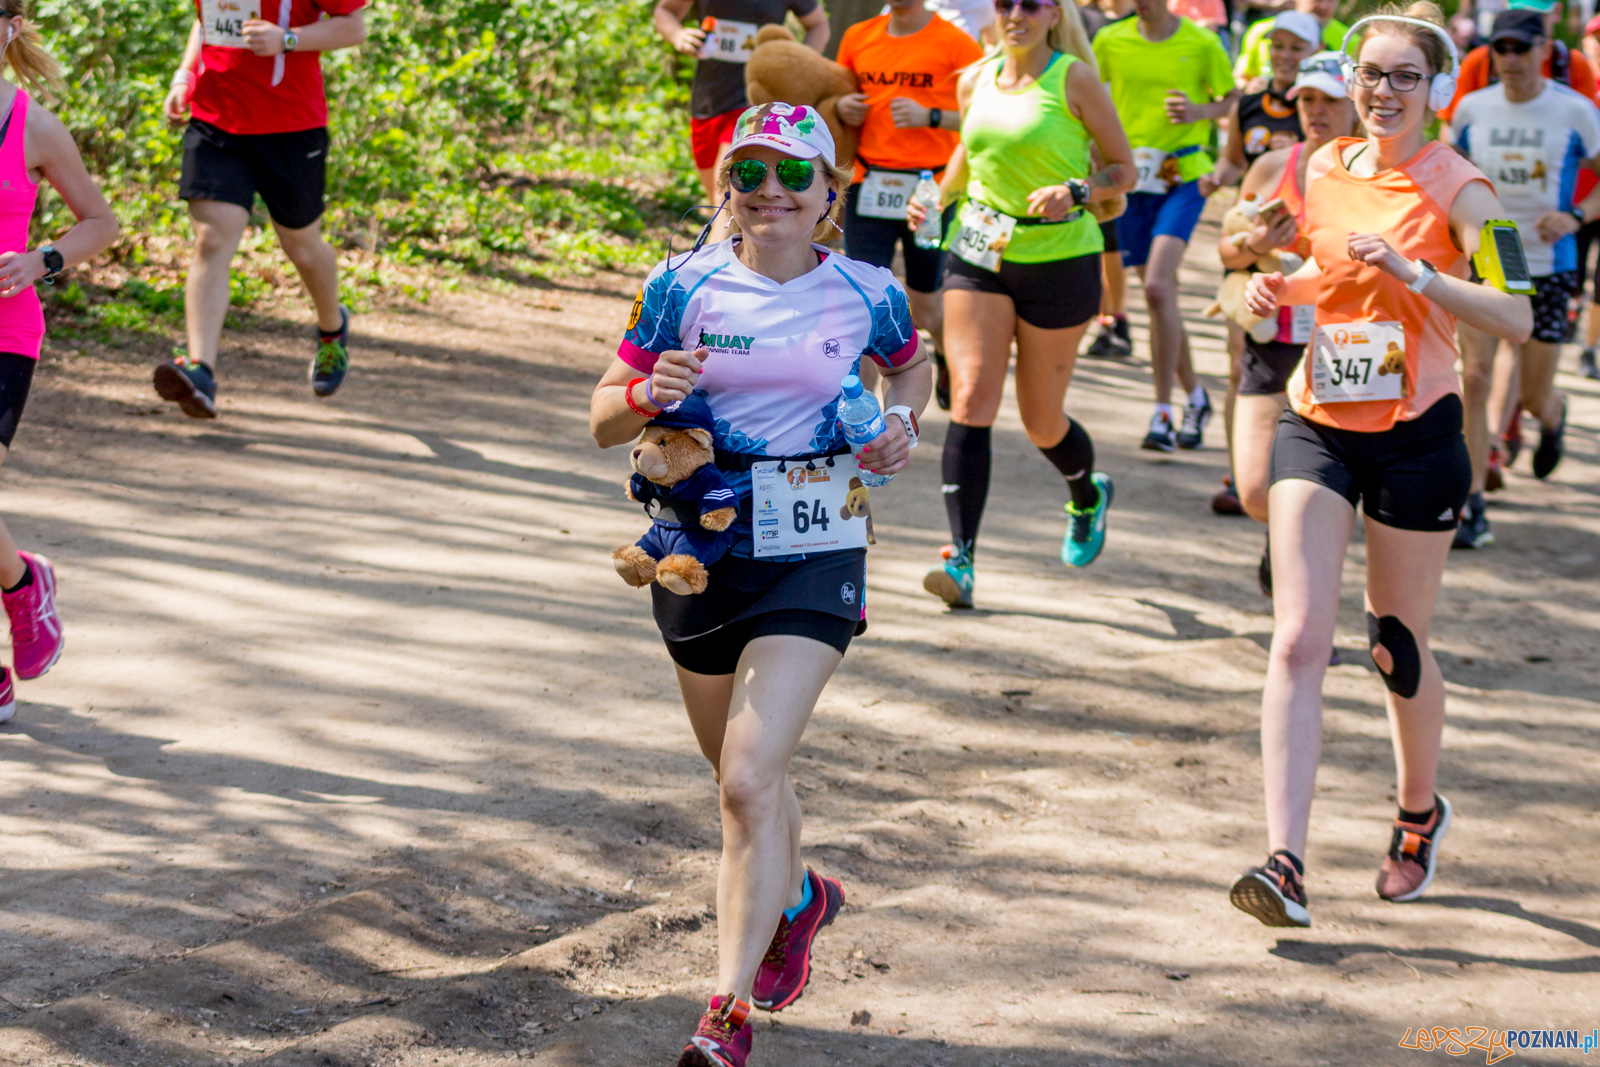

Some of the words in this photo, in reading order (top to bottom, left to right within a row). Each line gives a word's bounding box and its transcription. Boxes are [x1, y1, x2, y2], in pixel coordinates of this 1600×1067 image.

[215, 17, 243, 37] 443
[877, 191, 903, 209] 610
[961, 226, 990, 252] 405
[702, 333, 755, 350] MUAY
[708, 347, 729, 355] NNING
[1330, 357, 1373, 387] 347
[792, 498, 830, 534] 64
